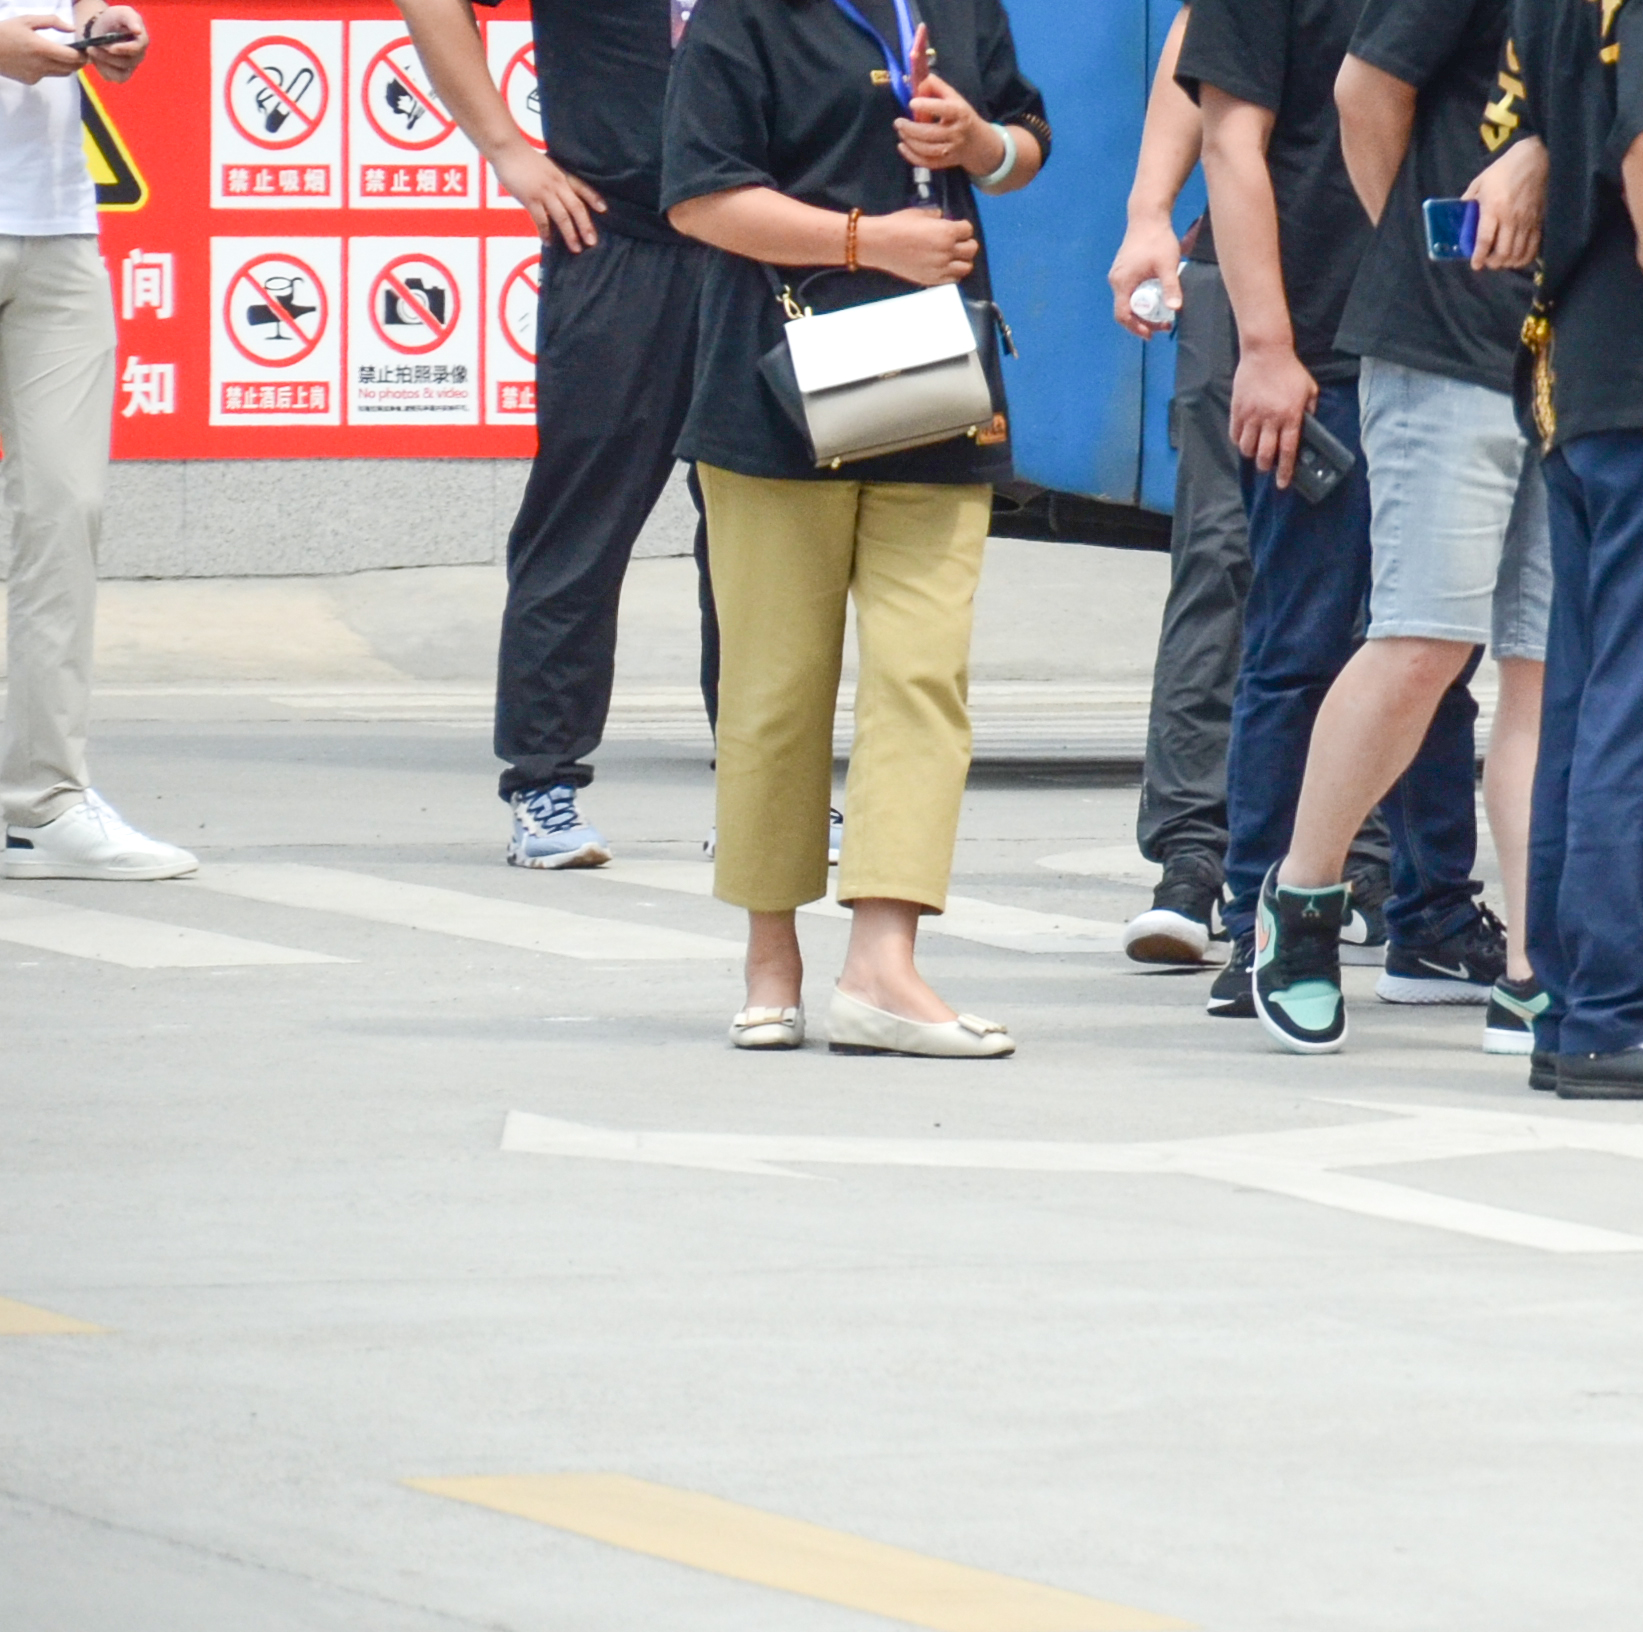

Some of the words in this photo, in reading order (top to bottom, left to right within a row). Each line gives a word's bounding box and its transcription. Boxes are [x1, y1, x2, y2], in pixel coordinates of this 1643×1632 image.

[229, 168, 326, 193] 禁止吸烟
[365, 168, 463, 193] 禁止烟火
[121, 249, 175, 320] 间
[121, 356, 175, 417] 知
[358, 365, 468, 384] 禁止拍照录像
[226, 386, 325, 410] 禁止酒后上岗
[358, 388, 376, 399] No
[378, 388, 420, 402] photos
[438, 388, 469, 399] video
[502, 386, 536, 409] 禁止
